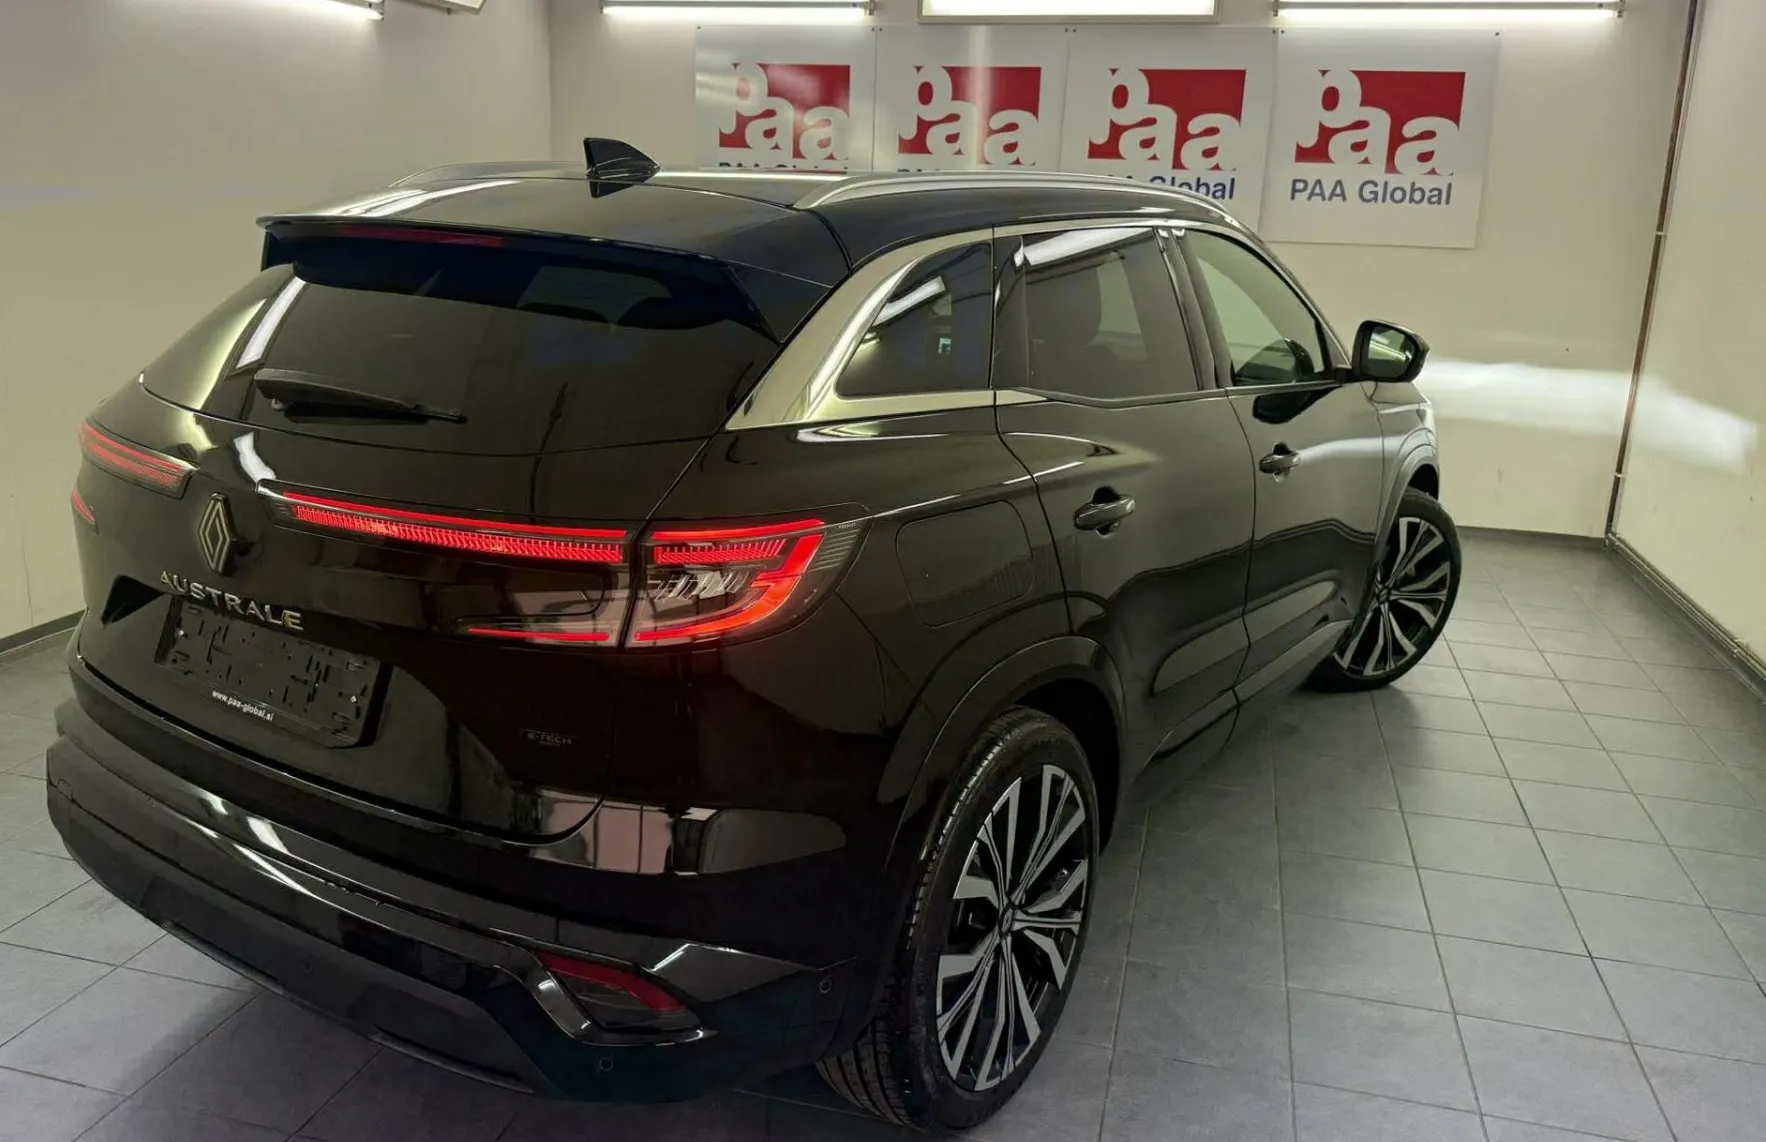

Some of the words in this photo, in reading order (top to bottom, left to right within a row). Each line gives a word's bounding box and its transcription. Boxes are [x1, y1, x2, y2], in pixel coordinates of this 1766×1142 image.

[1290, 178, 1347, 202] PAA
[1358, 180, 1453, 205] Global
[160, 570, 304, 632] AUSTRALE
[211, 690, 275, 722] www.paa-global.si
